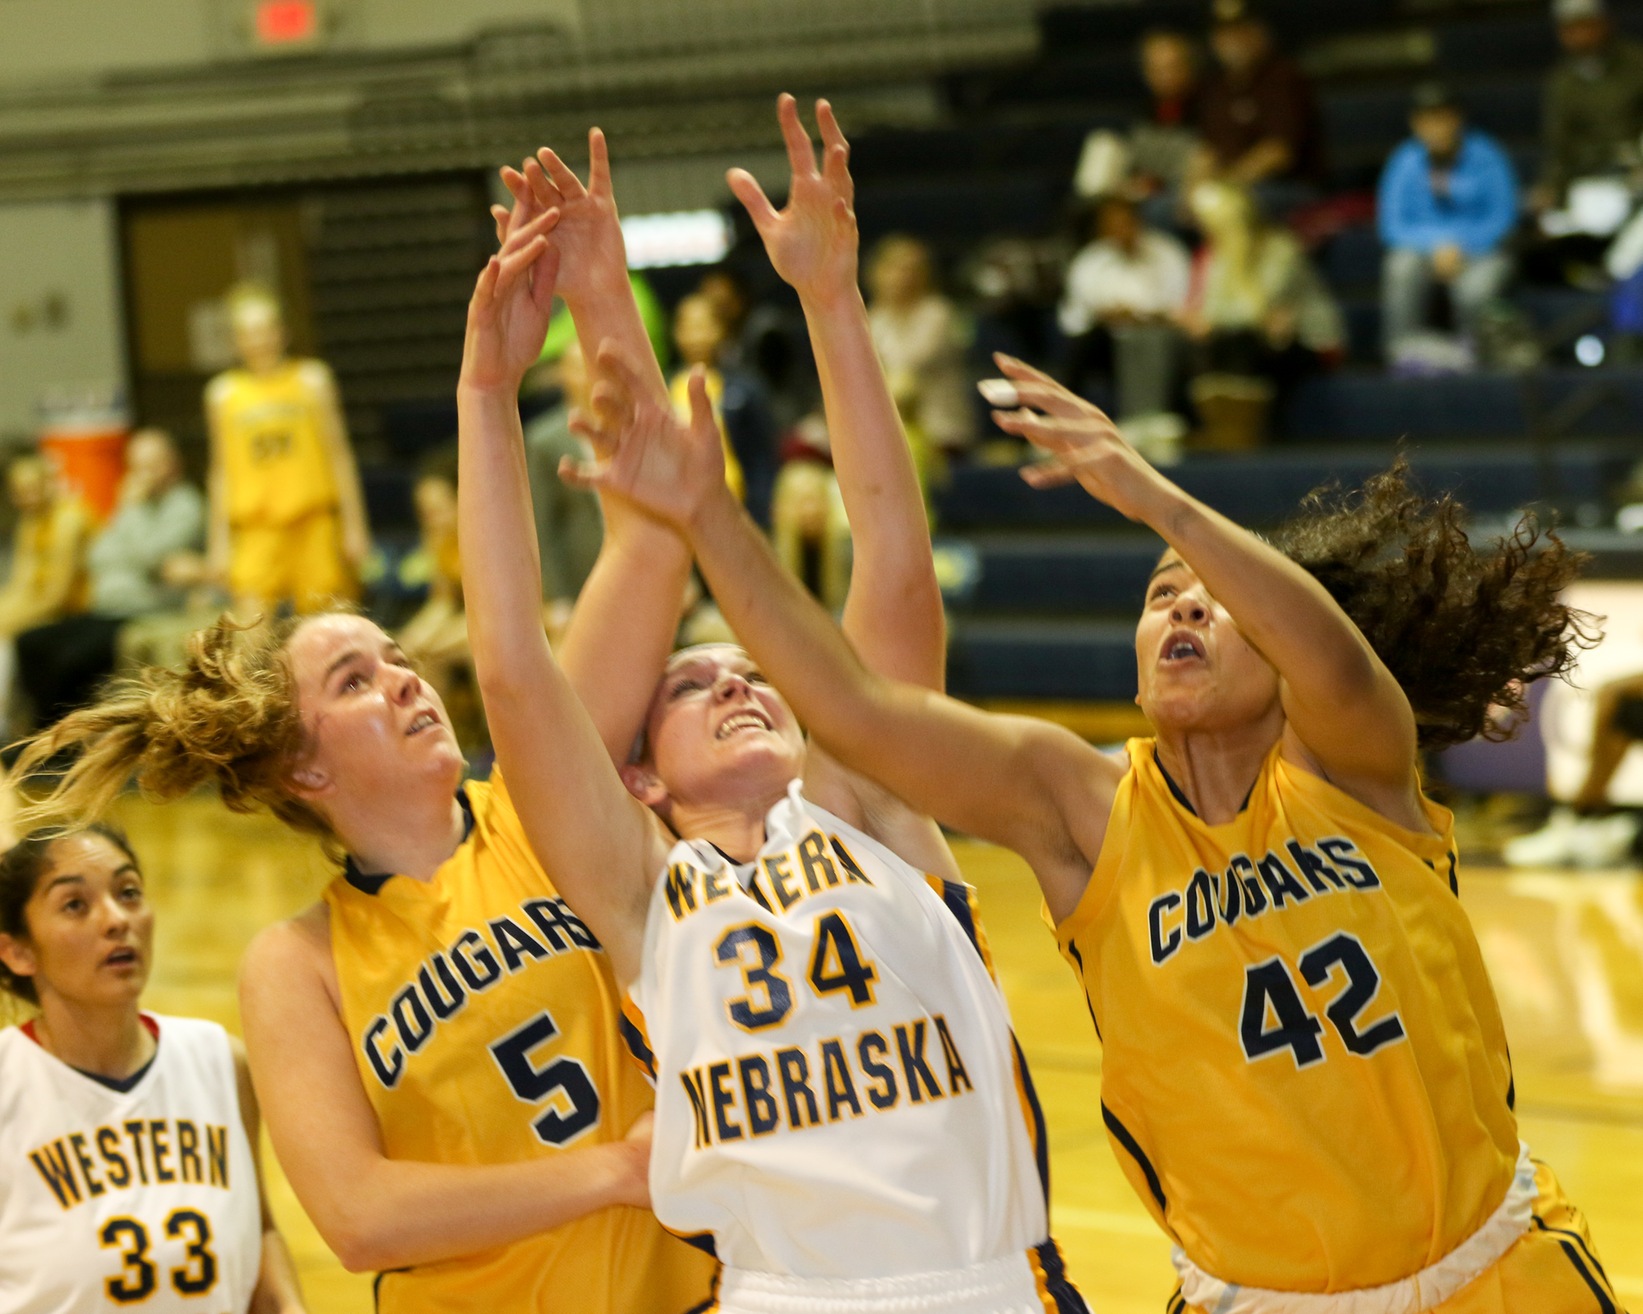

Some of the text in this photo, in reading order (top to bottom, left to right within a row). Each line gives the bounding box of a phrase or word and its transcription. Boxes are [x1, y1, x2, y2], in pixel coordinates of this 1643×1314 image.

[1148, 836, 1383, 968] COUGARS
[362, 895, 605, 1090] COUGARS
[711, 907, 880, 1034] 34
[1238, 929, 1408, 1071] 42
[486, 1008, 602, 1149] 5
[679, 1014, 974, 1152] NEBRASKA
[28, 1118, 231, 1211] WESTERN
[97, 1205, 220, 1308] 33
